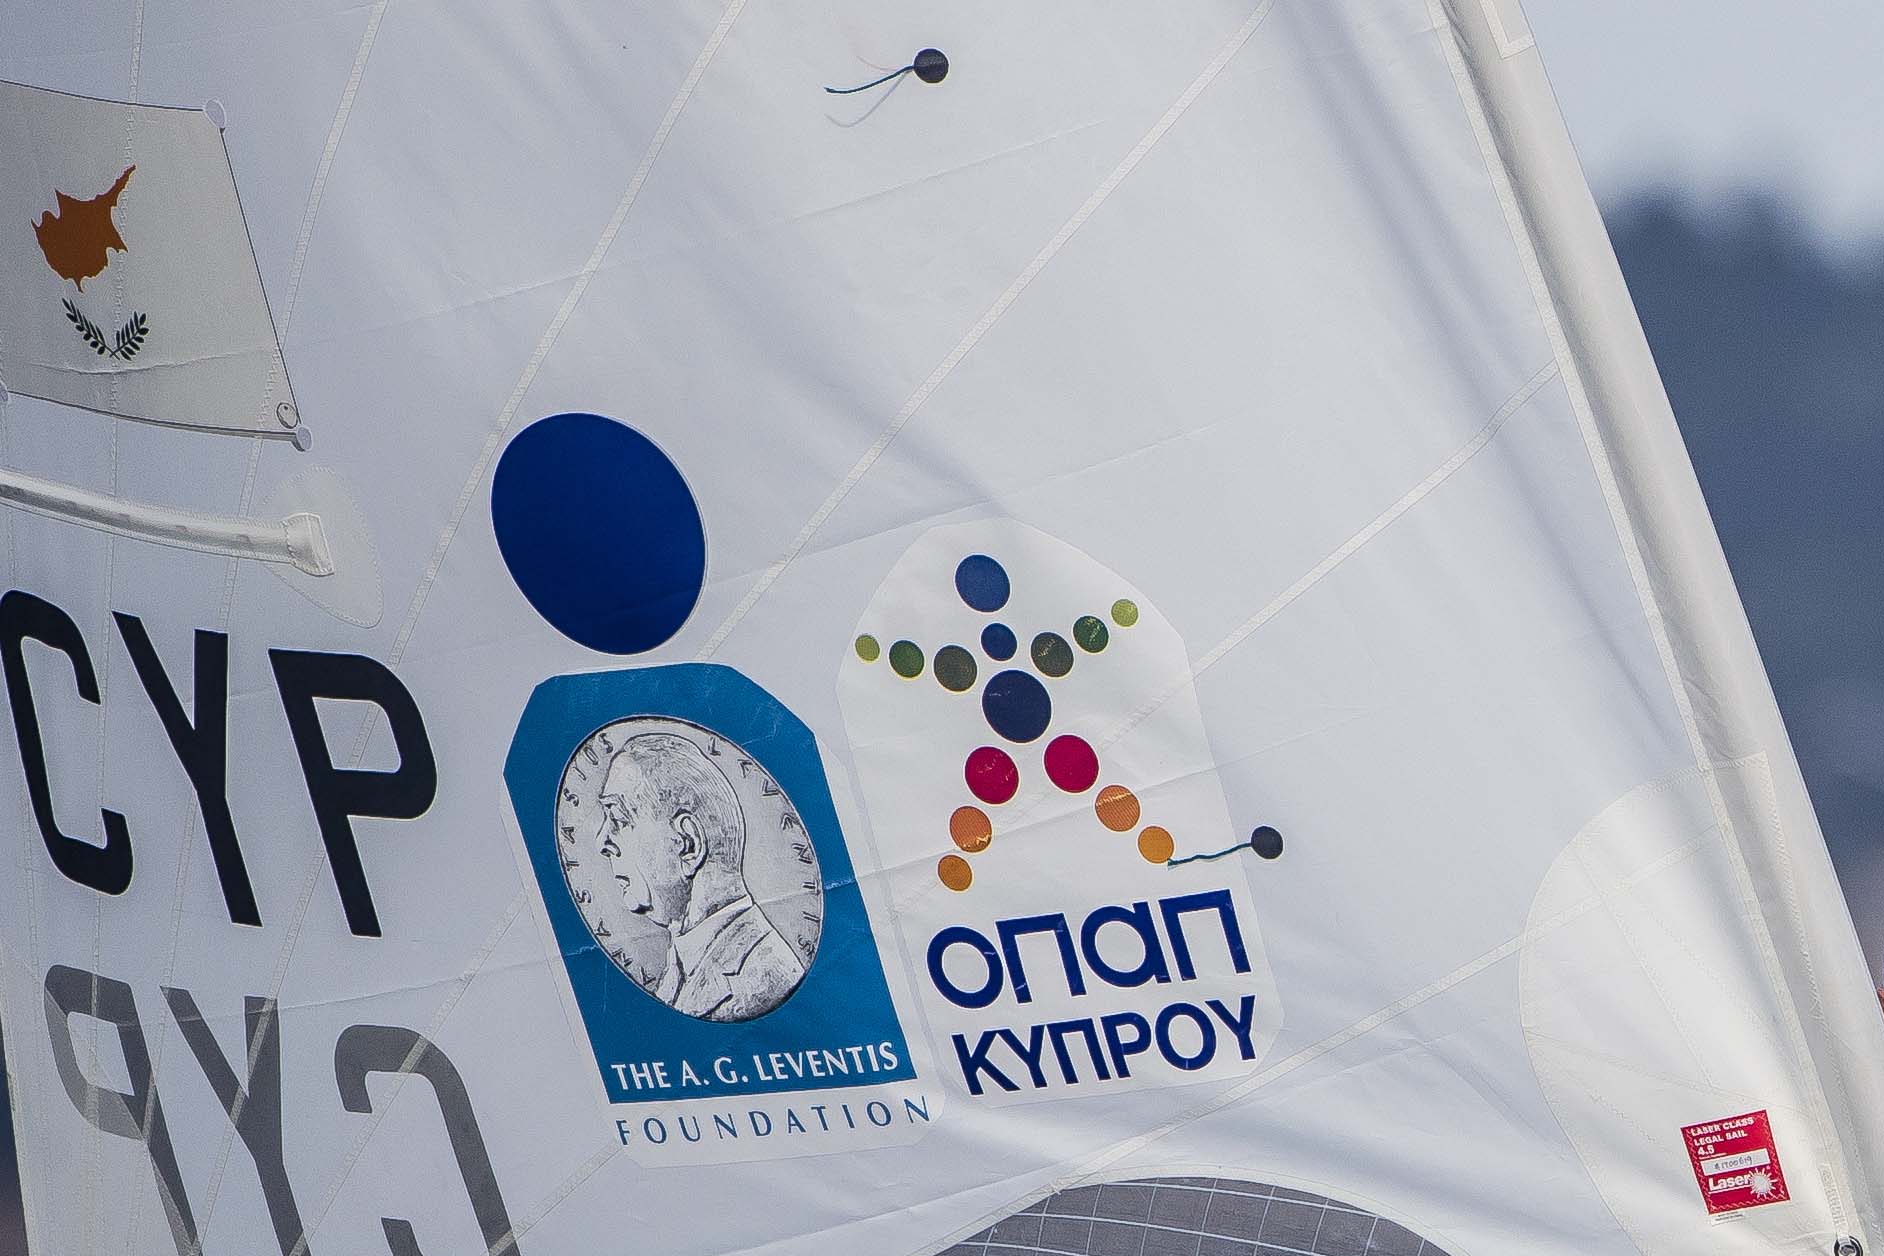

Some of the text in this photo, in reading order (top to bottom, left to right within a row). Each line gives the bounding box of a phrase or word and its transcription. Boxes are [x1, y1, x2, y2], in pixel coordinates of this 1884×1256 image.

[0, 588, 438, 938] CYP
[611, 1041, 899, 1091] THE A. G. LEVENTIS
[951, 994, 1257, 1096] ΚΥΠΡΟΥ
[615, 1095, 930, 1146] FOUNDATION
[1690, 1117, 1755, 1137] LASER CLASS
[1694, 1129, 1748, 1146] LEGAL SAIL
[1708, 1175, 1752, 1192] Laser
